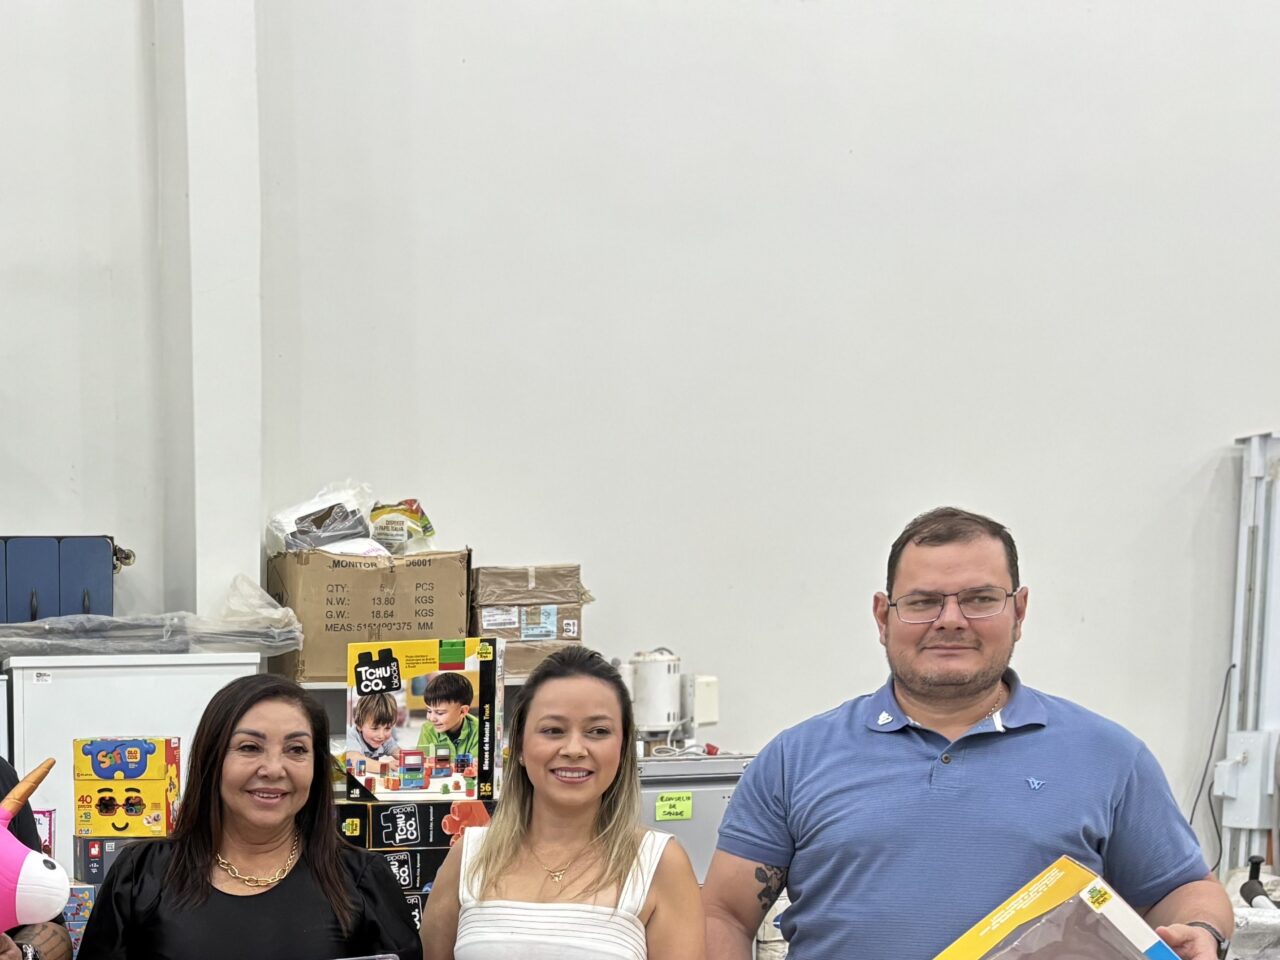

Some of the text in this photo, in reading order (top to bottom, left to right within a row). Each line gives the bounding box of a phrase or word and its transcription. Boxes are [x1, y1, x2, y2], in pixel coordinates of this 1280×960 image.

[332, 559, 377, 569] MONITOR
[326, 584, 349, 593] QTY:
[415, 582, 434, 592] PCS
[415, 596, 434, 605] KGS
[325, 610, 350, 619] G.W.:
[415, 609, 434, 618] KGS
[325, 624, 355, 632] MEAS:
[417, 622, 434, 631] MM
[356, 665, 390, 678] TCHU
[391, 661, 400, 688] blocks
[360, 680, 386, 693] CO.
[480, 783, 491, 792] 56
[78, 794, 93, 804] 40
[395, 814, 406, 843] TCHU
[406, 817, 417, 840] CO.
[400, 865, 409, 884] CO.
